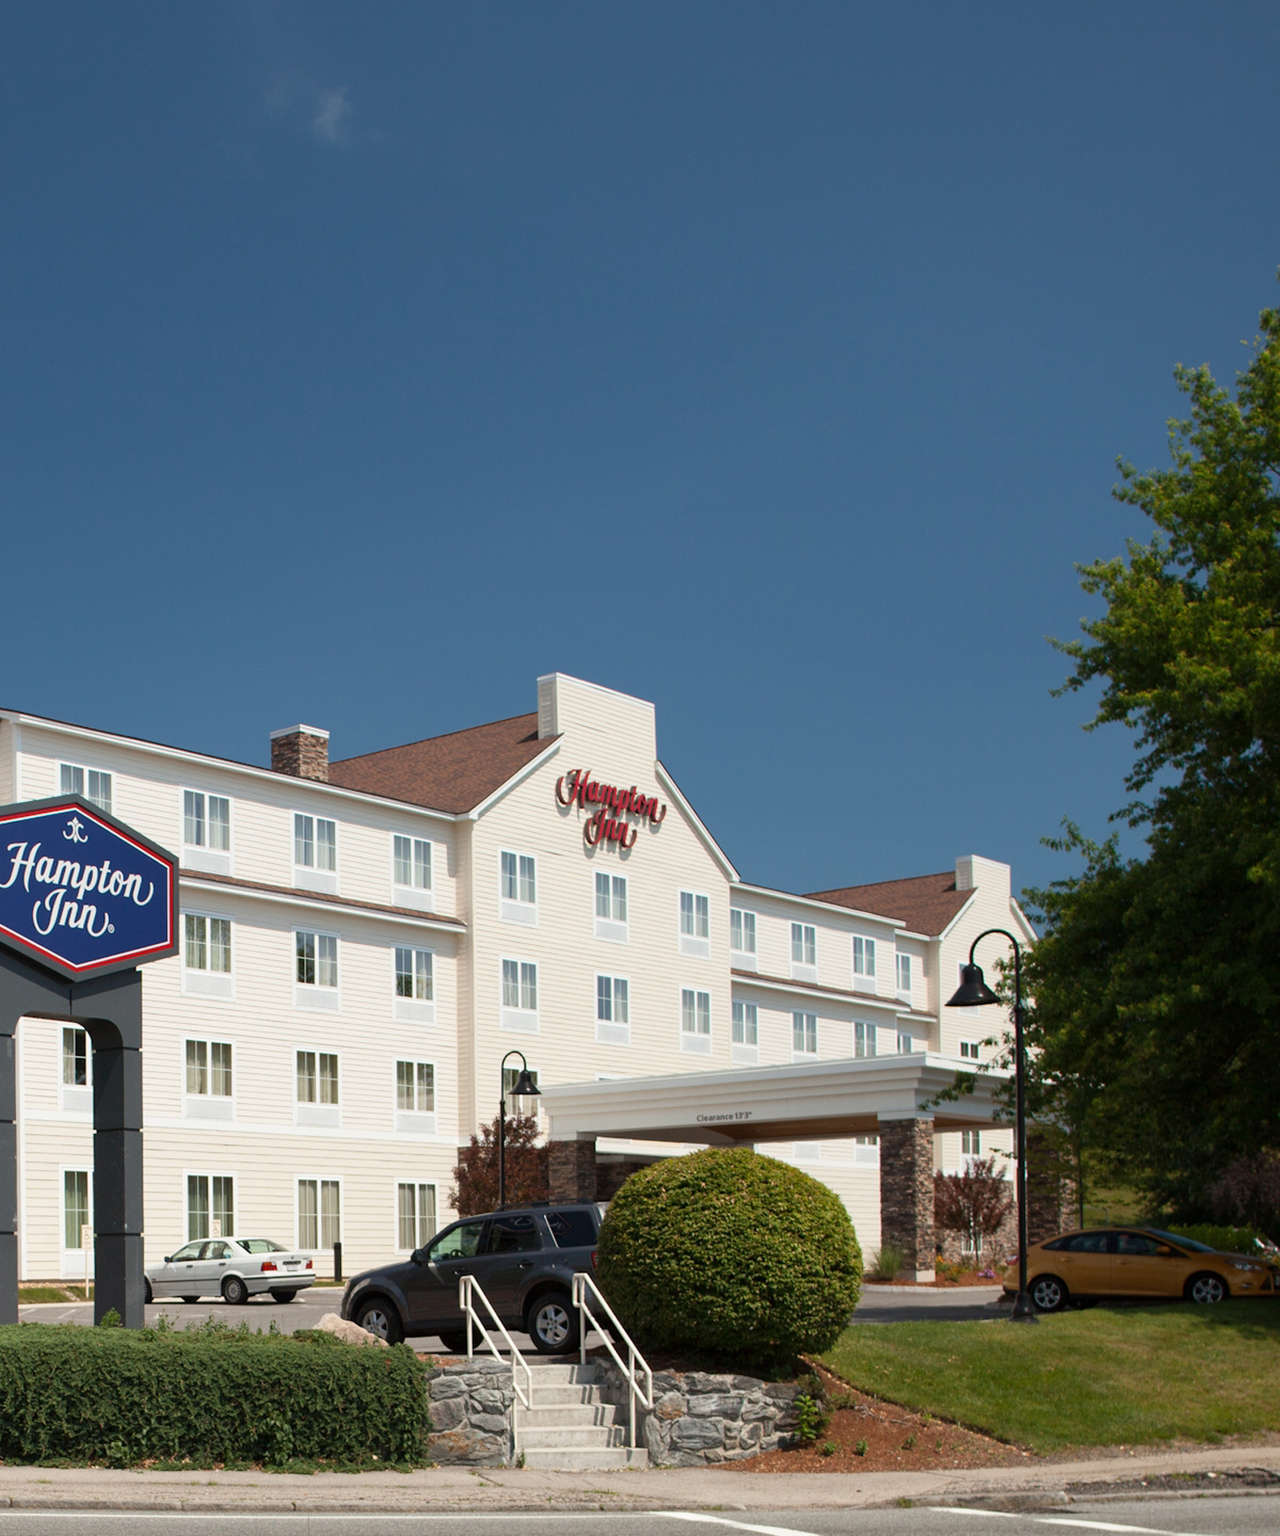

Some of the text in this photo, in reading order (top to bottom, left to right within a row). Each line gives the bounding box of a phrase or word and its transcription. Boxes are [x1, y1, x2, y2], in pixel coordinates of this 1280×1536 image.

[555, 769, 666, 823] Hampton
[583, 808, 637, 848] Inn
[696, 1112, 733, 1121] Clearance
